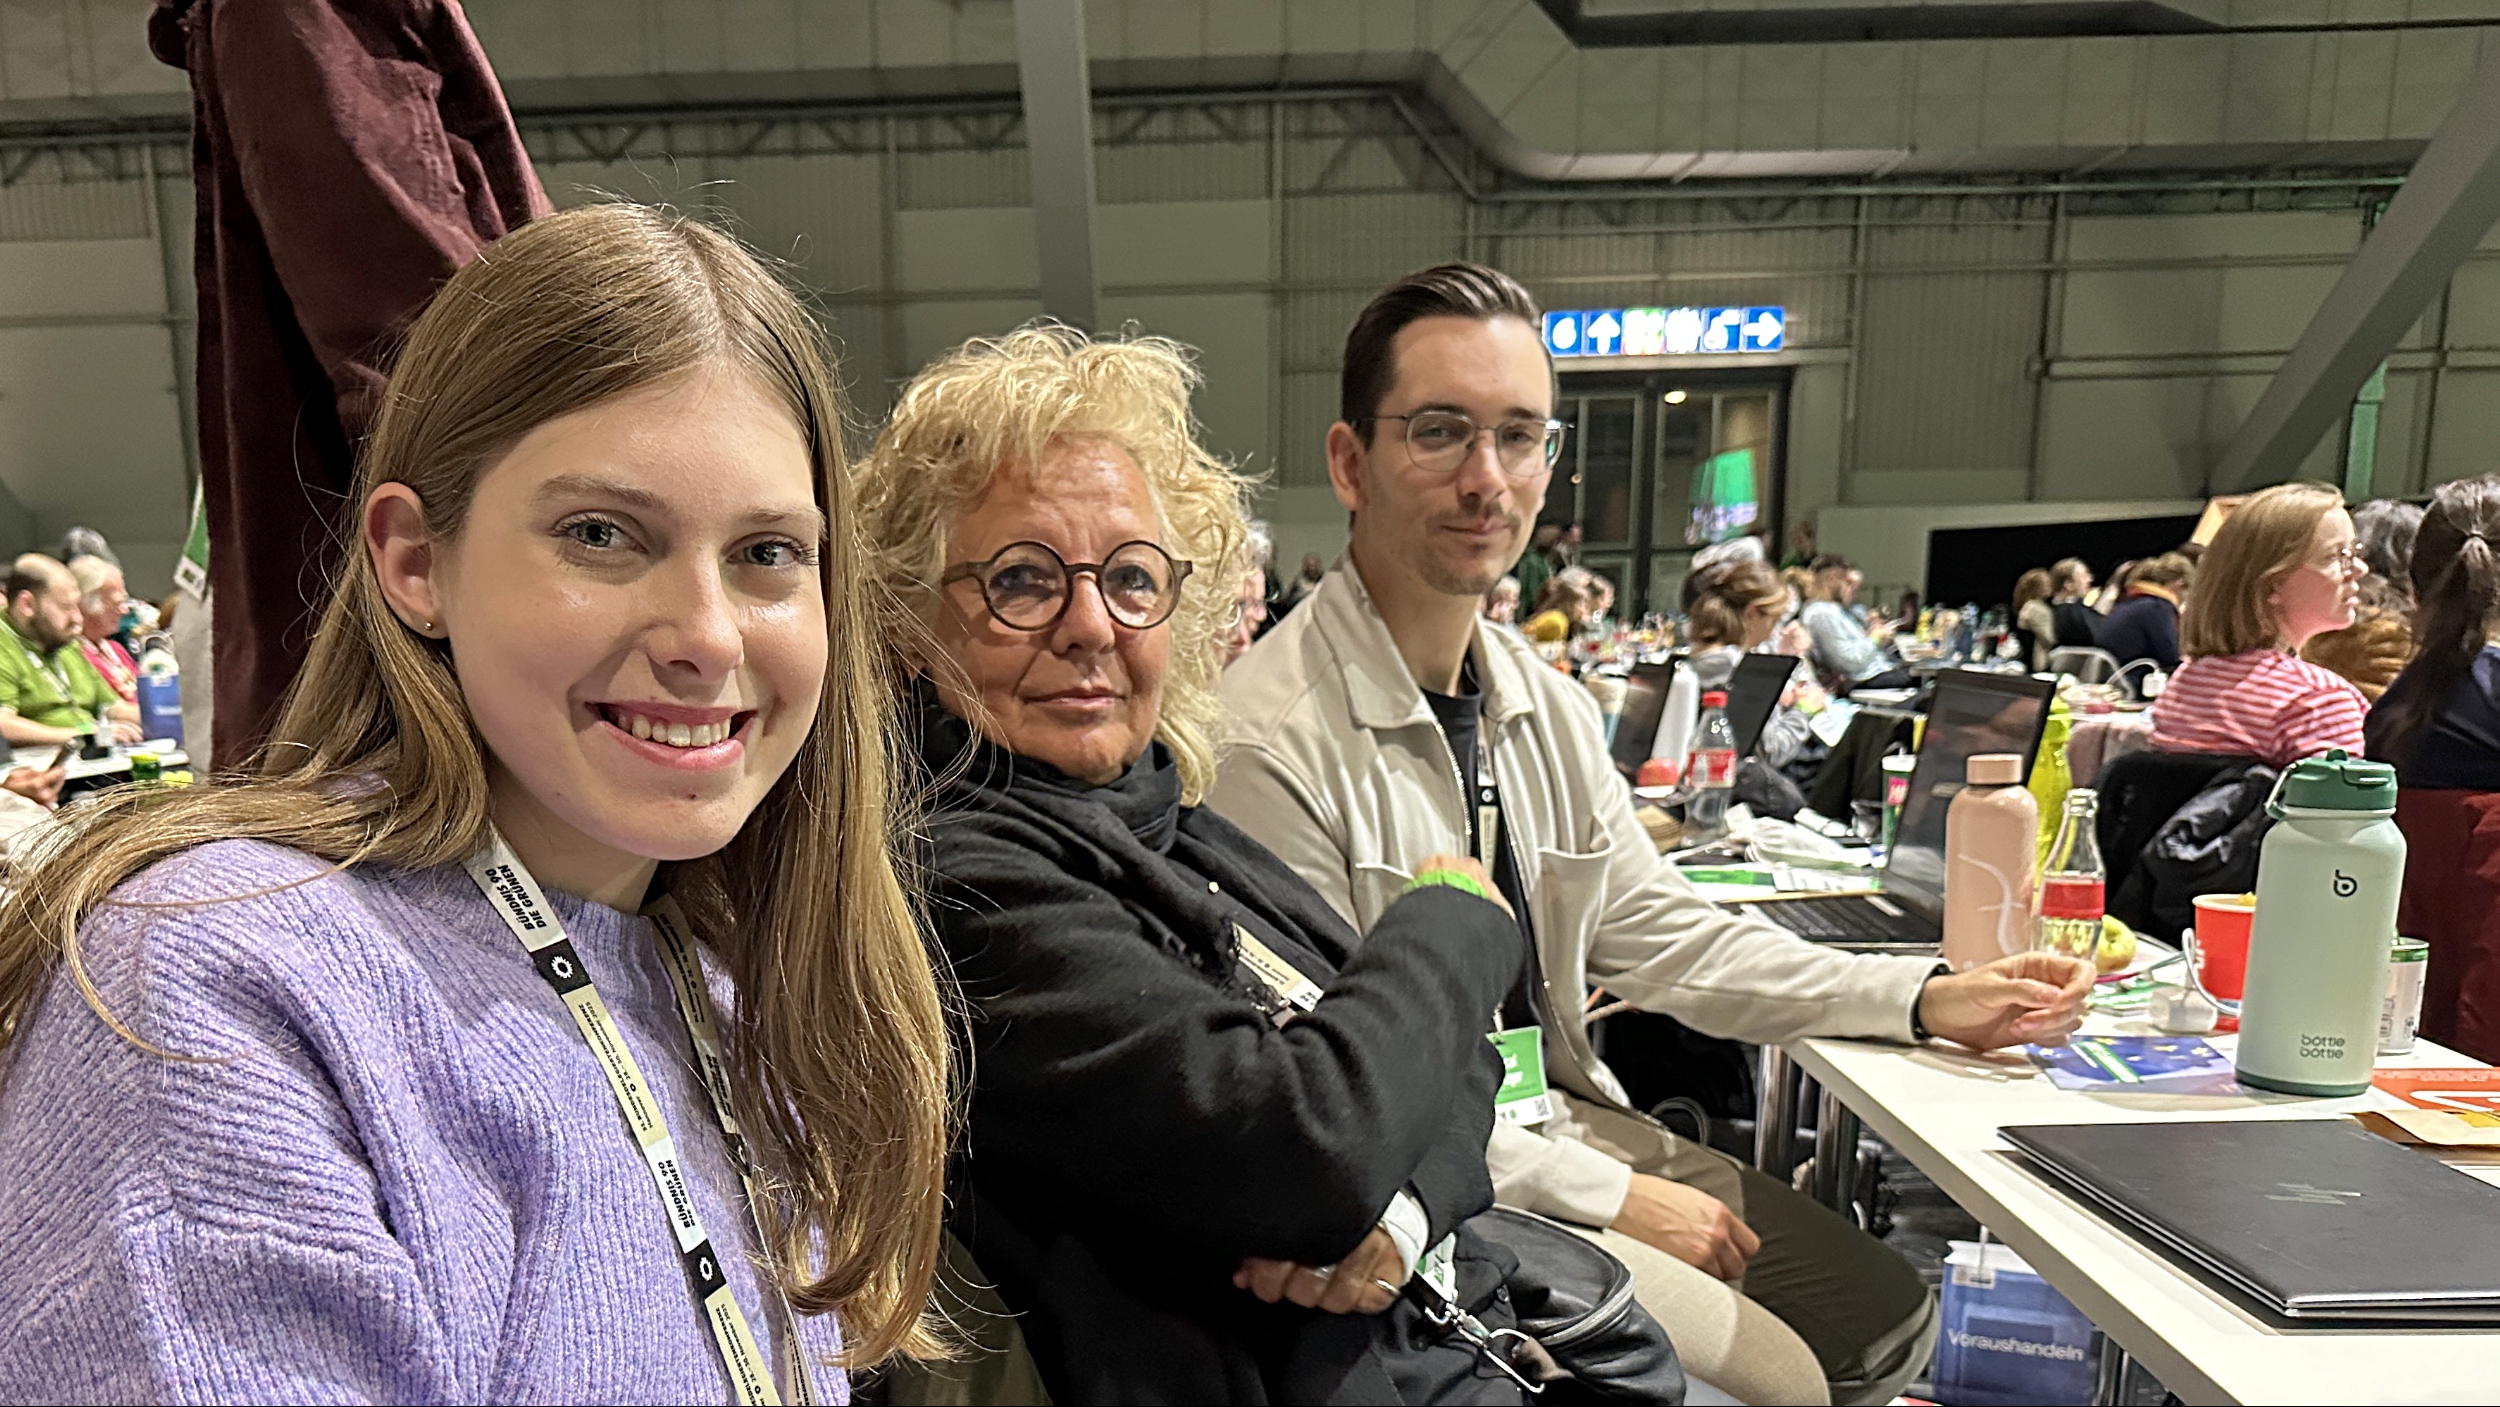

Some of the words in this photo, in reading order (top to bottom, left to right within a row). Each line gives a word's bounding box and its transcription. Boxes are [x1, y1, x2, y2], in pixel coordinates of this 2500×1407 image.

[484, 867, 501, 884] 90
[497, 864, 533, 908] GRÜNEN
[496, 883, 535, 931] BÜNDNIS
[528, 909, 546, 927] DIE
[585, 1001, 597, 1018] 2025
[595, 1019, 616, 1053] November
[635, 1095, 653, 1128] Hannover
[657, 1161, 668, 1177] 90
[665, 1159, 687, 1204] GRÜNEN
[665, 1179, 691, 1228] BÜNDNIS
[686, 1208, 695, 1226] DIE
[720, 1303, 730, 1319] 2025
[728, 1321, 745, 1355] November
[1947, 1328, 2084, 1362] Voraushandeln
